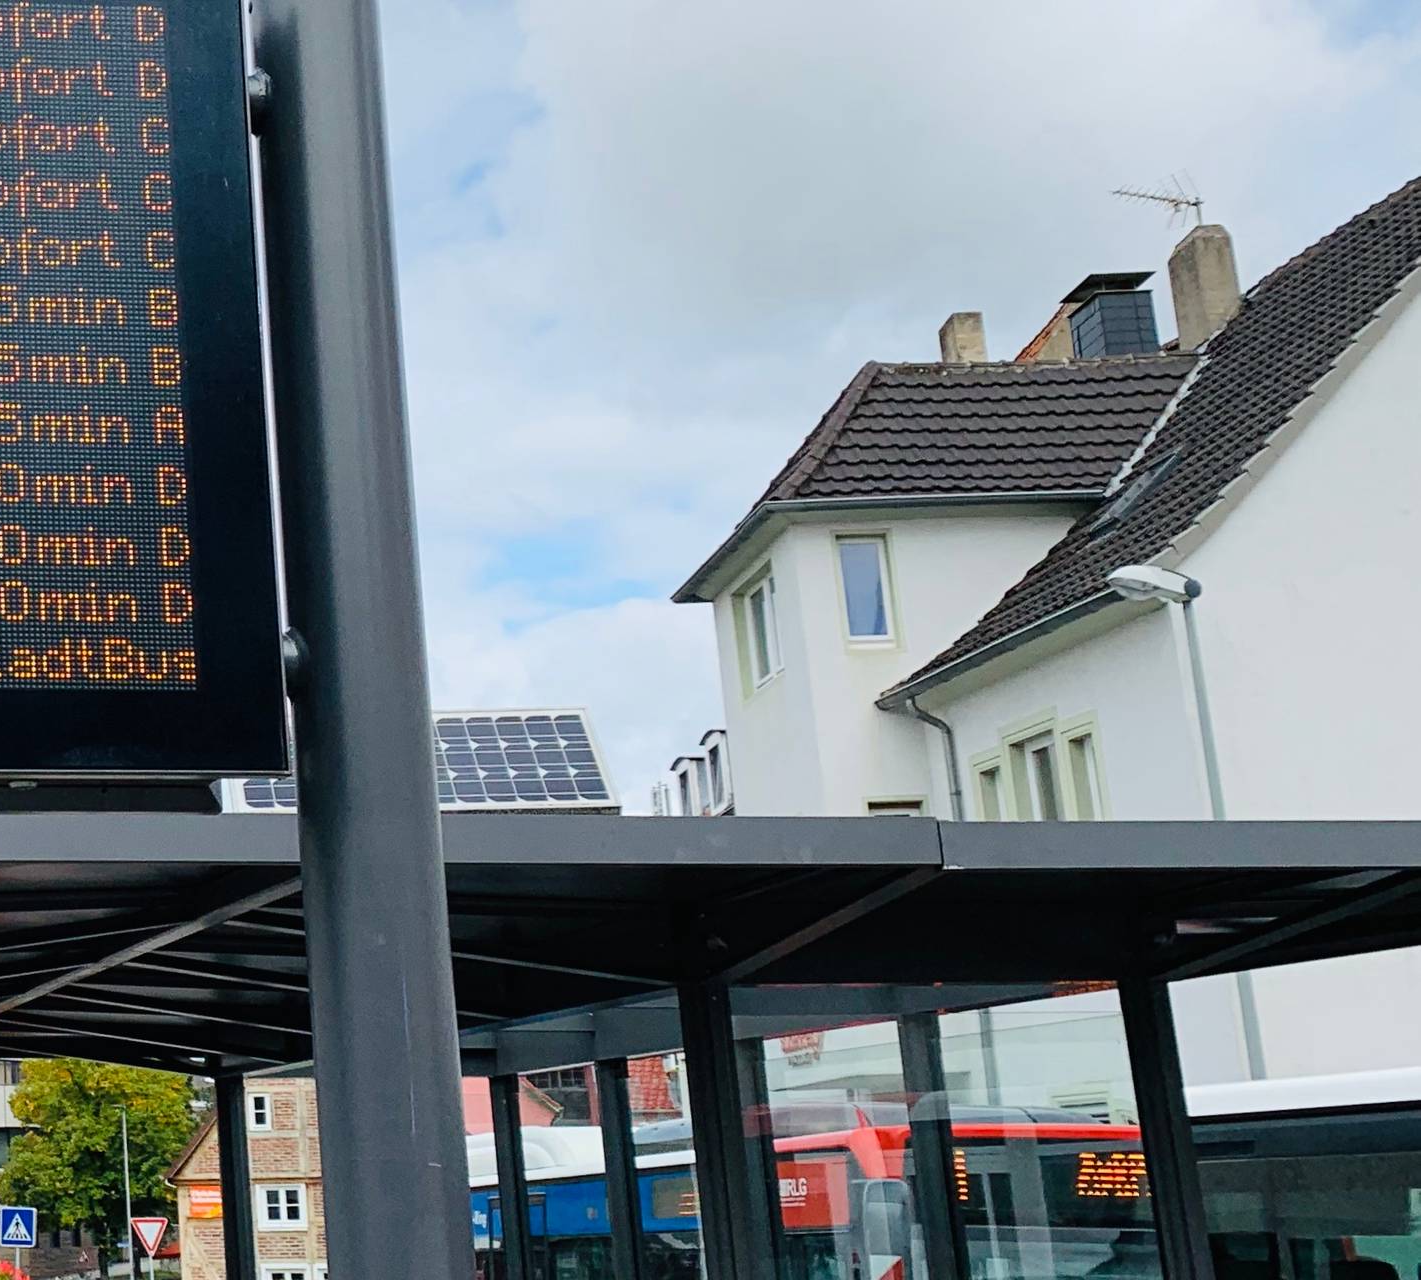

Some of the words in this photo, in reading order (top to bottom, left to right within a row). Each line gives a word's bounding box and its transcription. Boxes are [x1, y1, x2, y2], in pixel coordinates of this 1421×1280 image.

[135, 6, 165, 42] D
[138, 61, 167, 97] D
[141, 117, 170, 153] C
[144, 174, 172, 211] C
[146, 231, 175, 269] C
[149, 287, 178, 328] B
[152, 347, 182, 387] B
[154, 405, 185, 446] A
[157, 465, 187, 506] D
[160, 526, 191, 568] D
[162, 582, 194, 625] D
